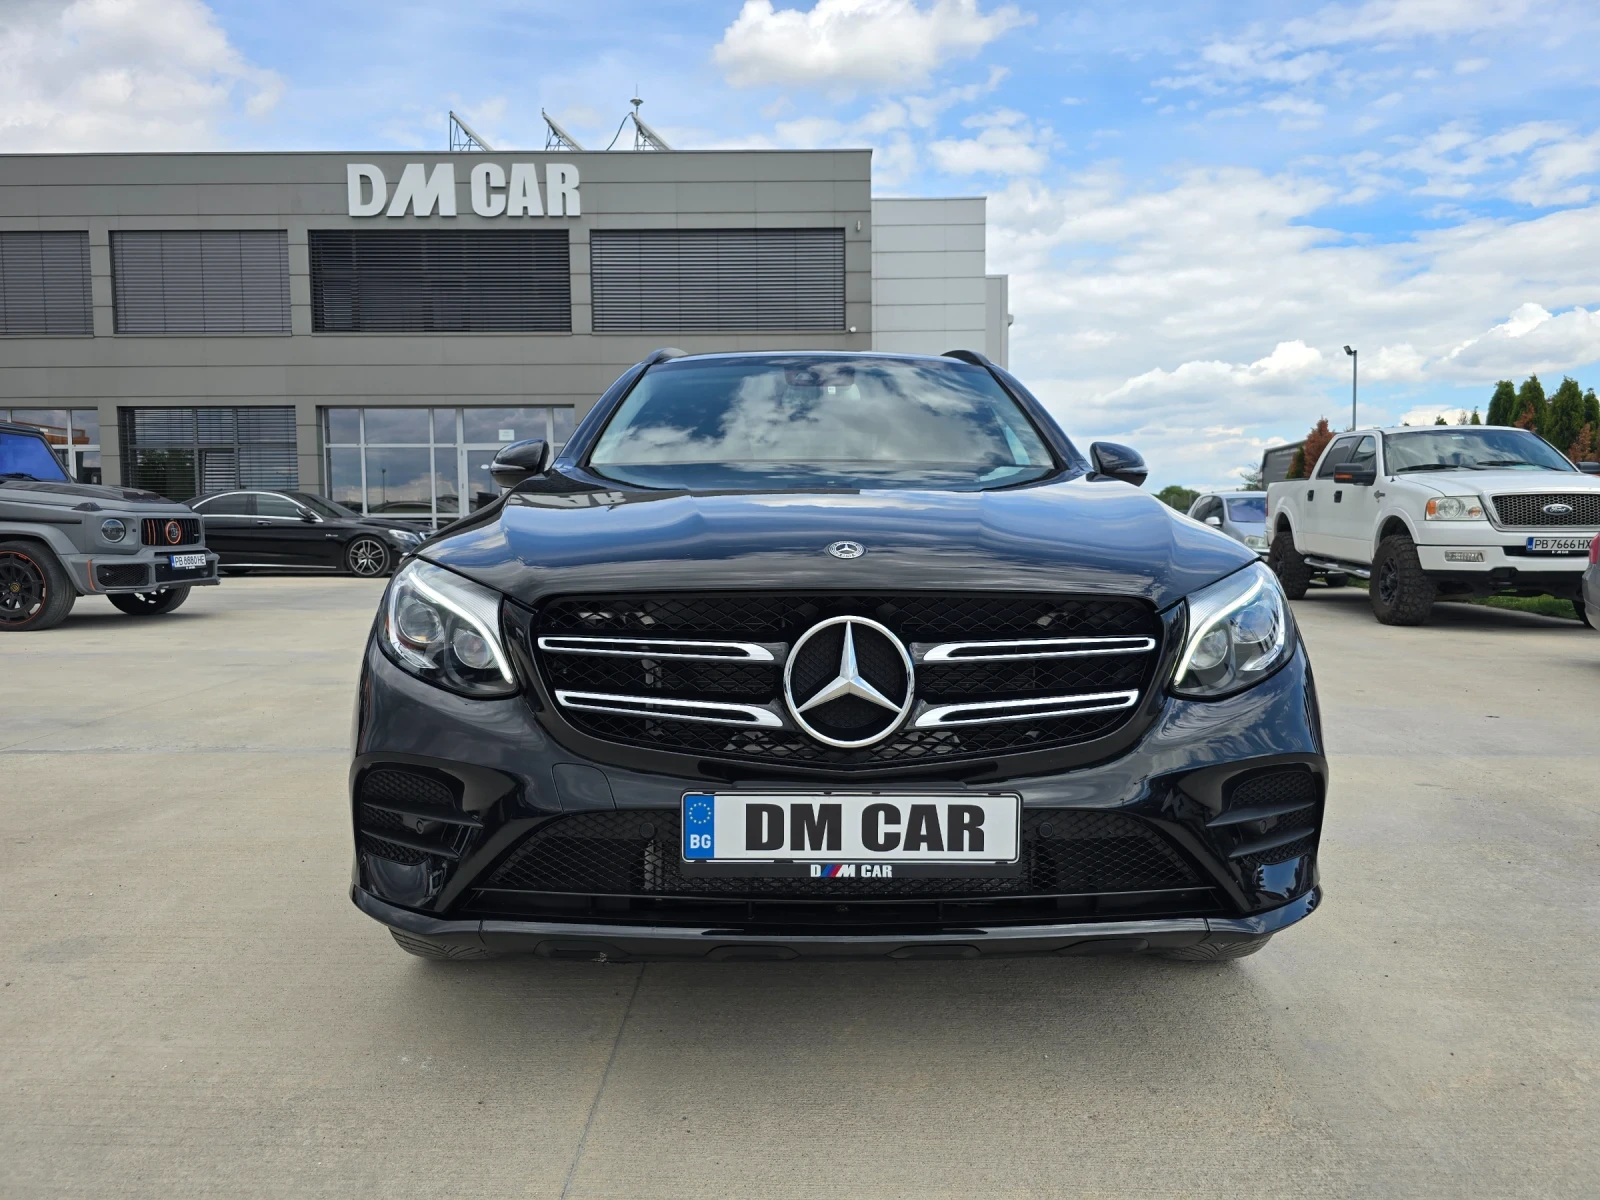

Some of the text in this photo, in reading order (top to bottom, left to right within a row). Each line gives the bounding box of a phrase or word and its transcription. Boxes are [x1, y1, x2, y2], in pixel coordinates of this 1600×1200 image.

[347, 162, 581, 217] DM CAR
[1534, 540, 1548, 549] PB
[1550, 540, 1576, 549] 7666
[175, 556, 183, 565] PB
[745, 802, 985, 852] DM CAR
[689, 834, 711, 849] BG
[861, 864, 893, 878] CAR
